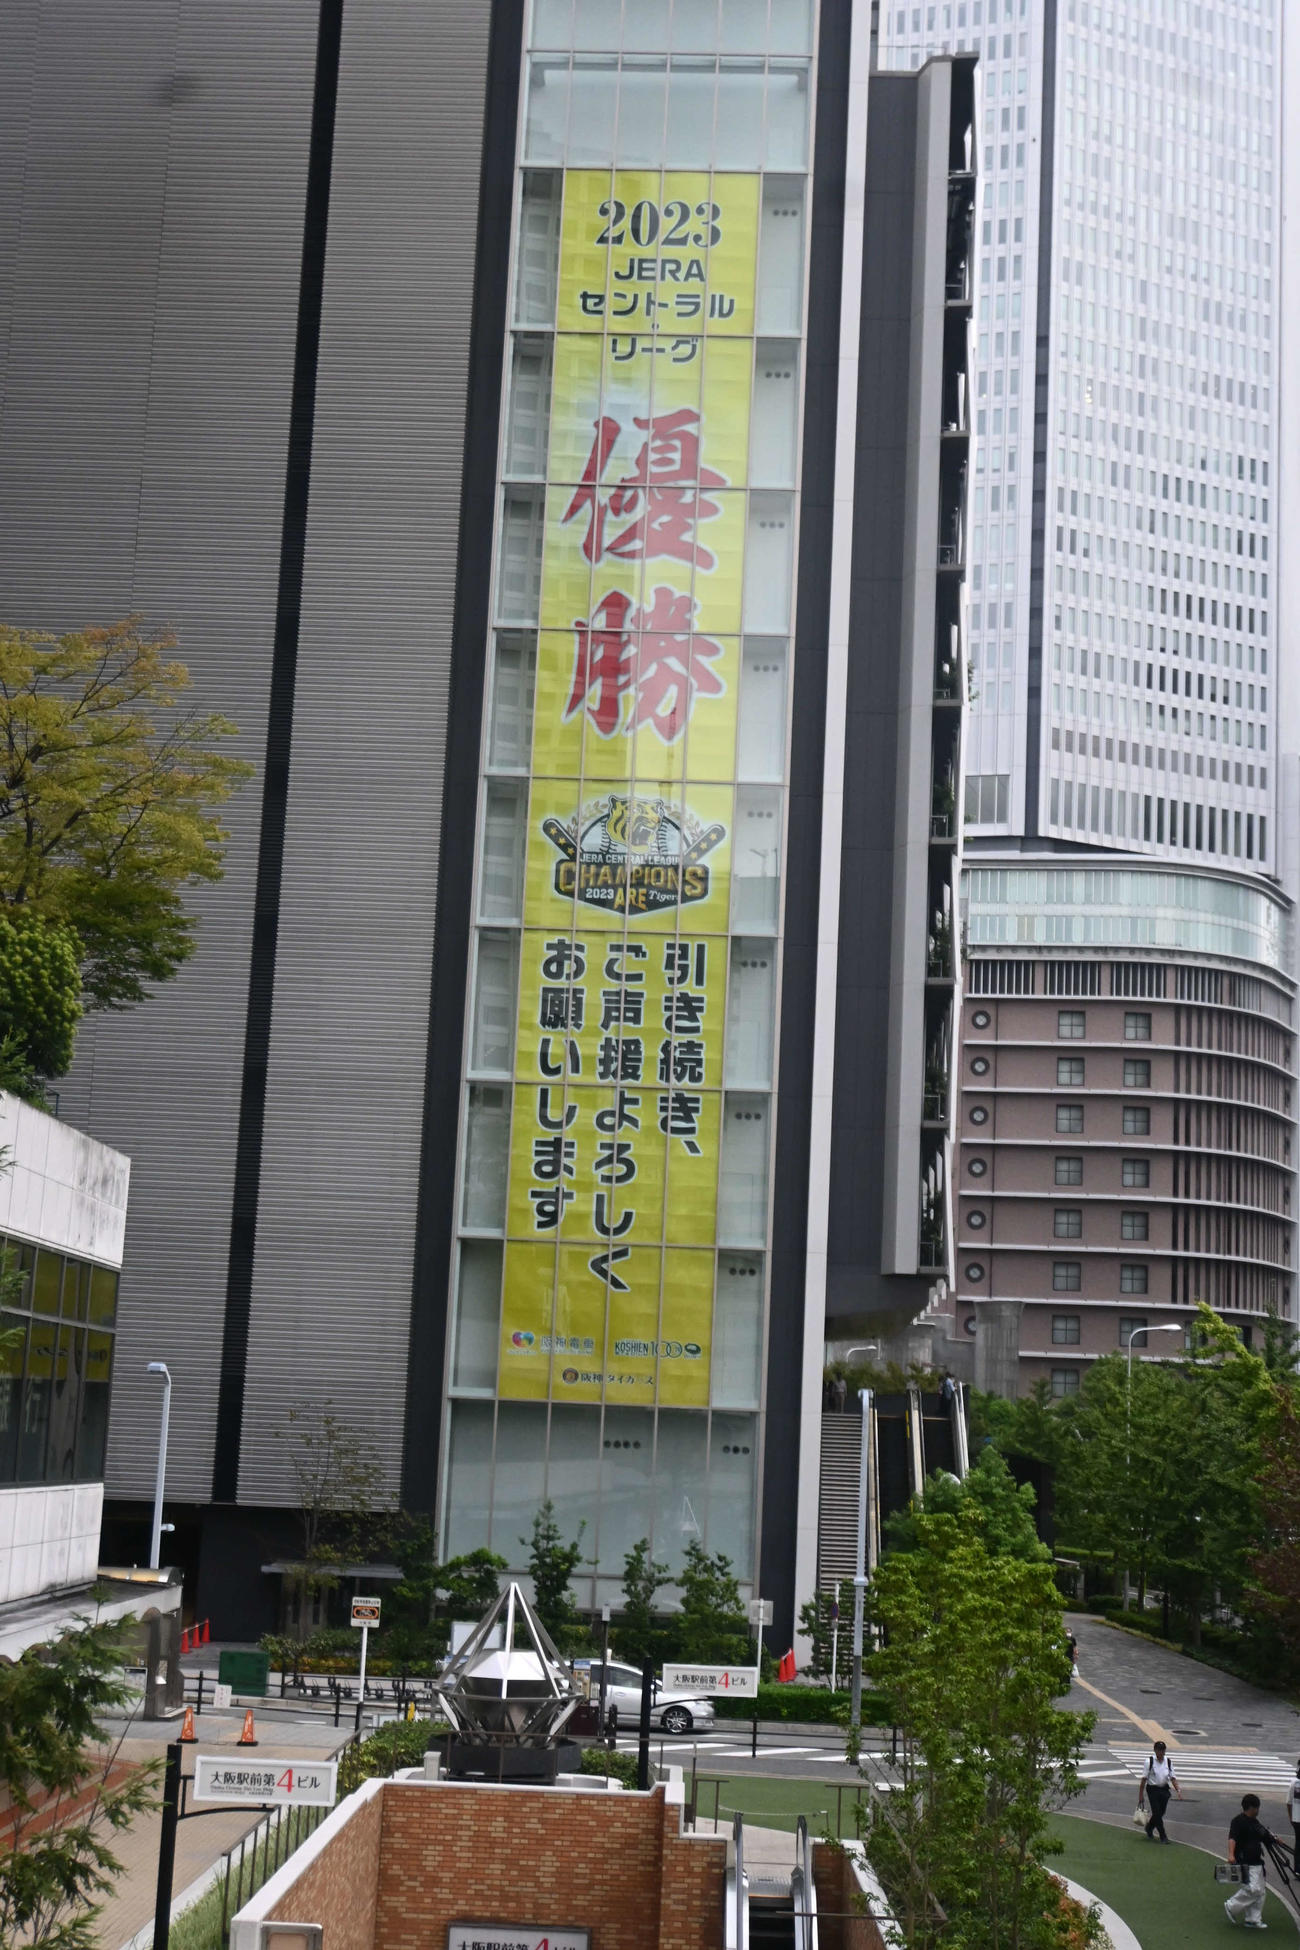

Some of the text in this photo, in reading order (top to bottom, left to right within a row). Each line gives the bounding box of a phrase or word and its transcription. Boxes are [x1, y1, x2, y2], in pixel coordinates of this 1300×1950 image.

[595, 199, 722, 248] 2023
[613, 257, 706, 282] JERA
[579, 290, 735, 319] セントラル
[611, 337, 699, 363] リーグ
[561, 408, 728, 742] 優勝
[580, 853, 681, 865] JERA CENTRAL LEAGU
[559, 861, 705, 897] CHAMPIONS
[585, 887, 681, 912] 2023 ARE Tiger
[657, 942, 707, 1156] 引き続き、
[530, 938, 586, 1230] お願いします
[589, 943, 647, 1292] ご声援よろしく
[615, 1342, 649, 1353] KOSHIEN
[580, 1372, 653, 1385] 阪神タイガス
[210, 1769, 320, 1793] 大阪駅前第4ビル
